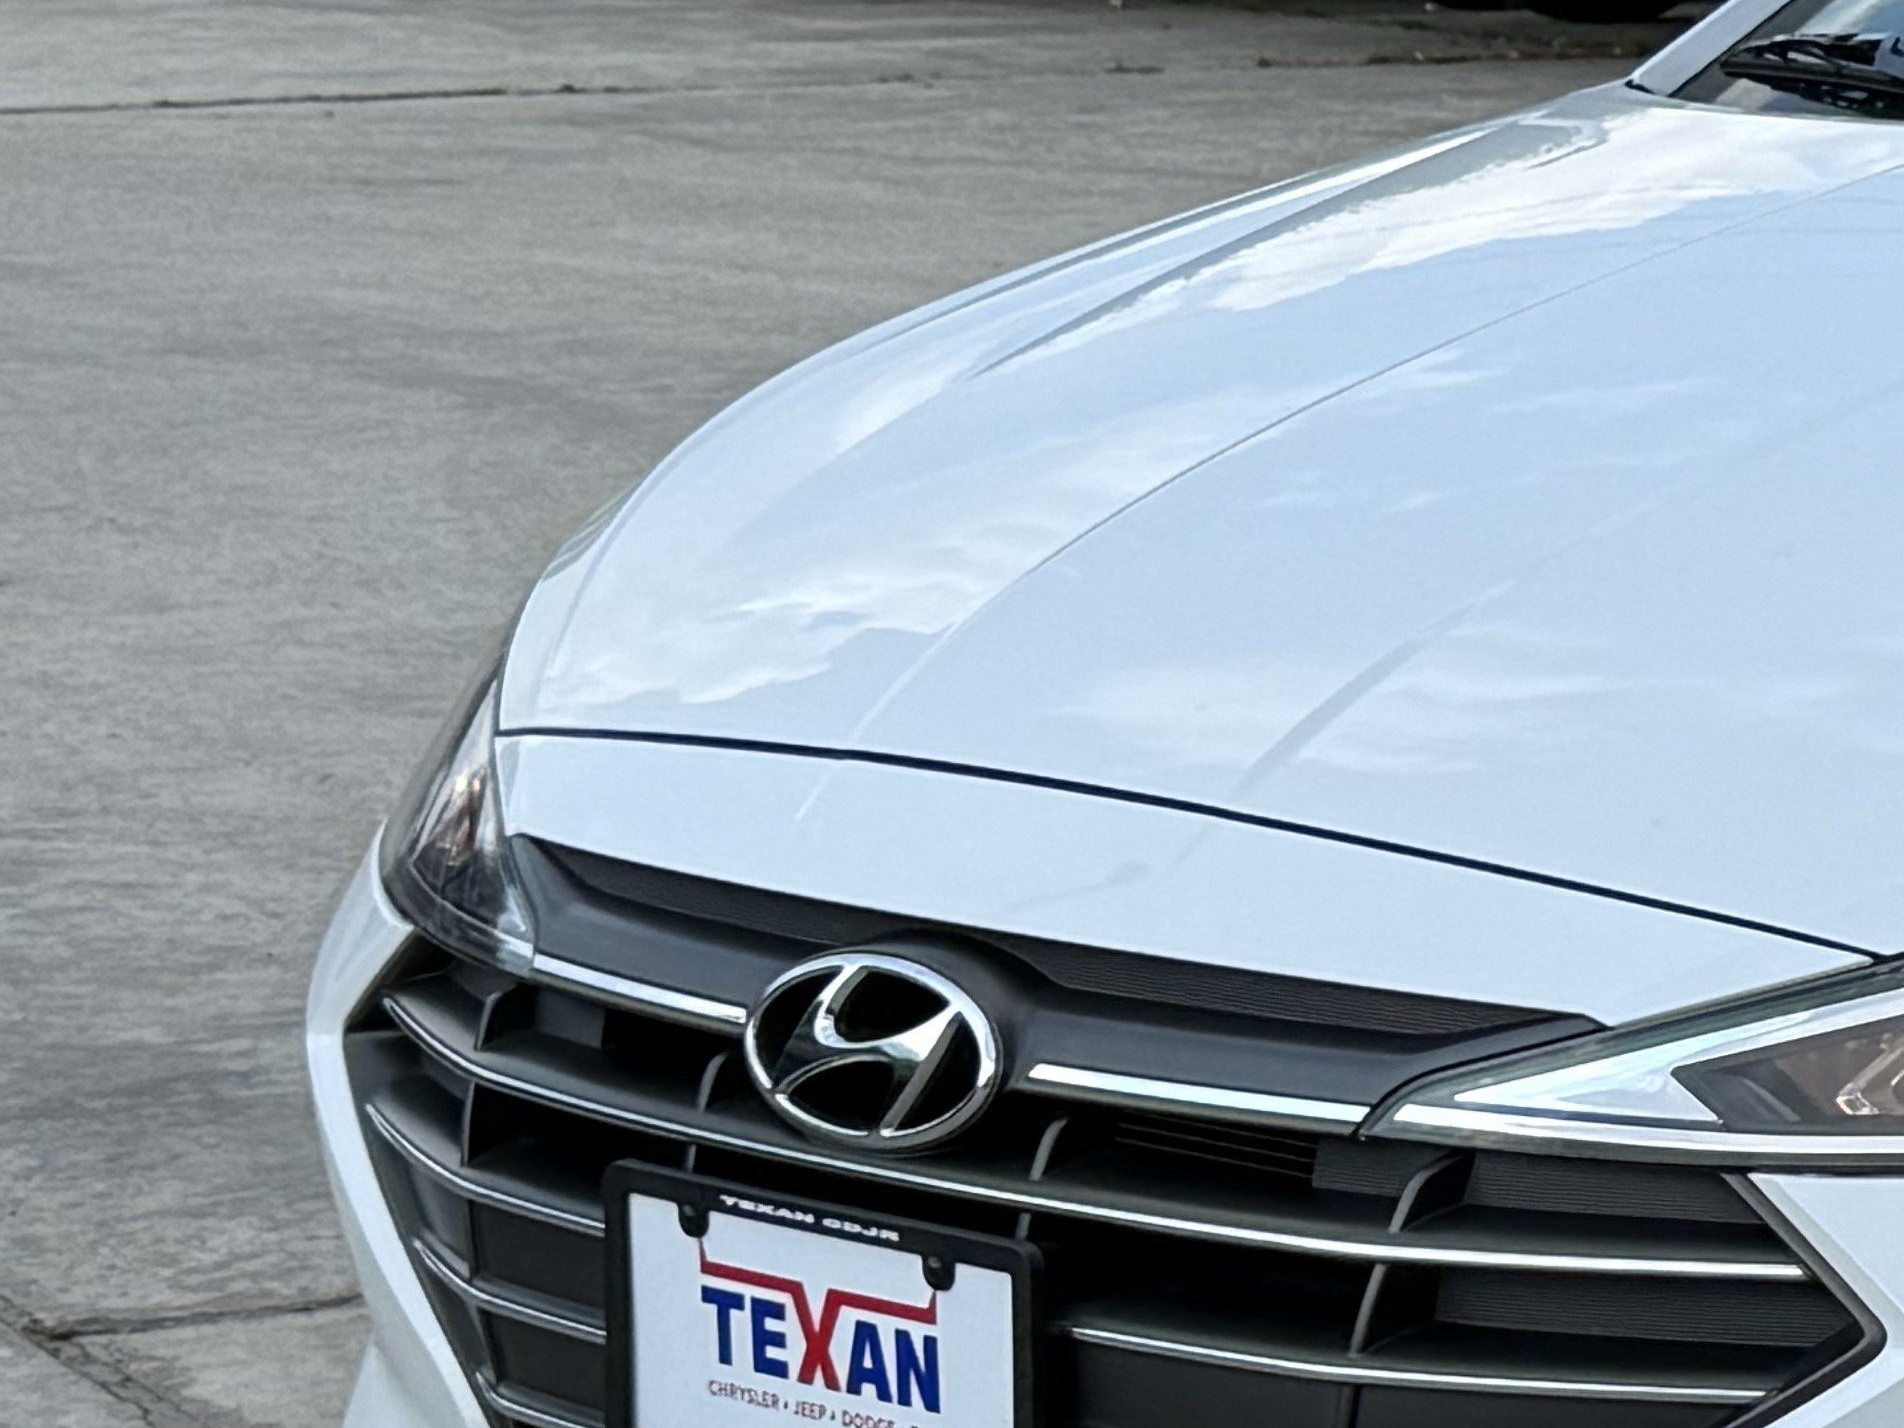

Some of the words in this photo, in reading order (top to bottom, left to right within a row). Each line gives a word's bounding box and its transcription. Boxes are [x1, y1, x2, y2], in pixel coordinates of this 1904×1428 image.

[719, 1194, 815, 1223] TEXAN
[822, 1218, 899, 1241] CDJR
[700, 1262, 942, 1415] TEXAN
[708, 1379, 780, 1410] CHRYSLER
[793, 1400, 826, 1421] JEEP
